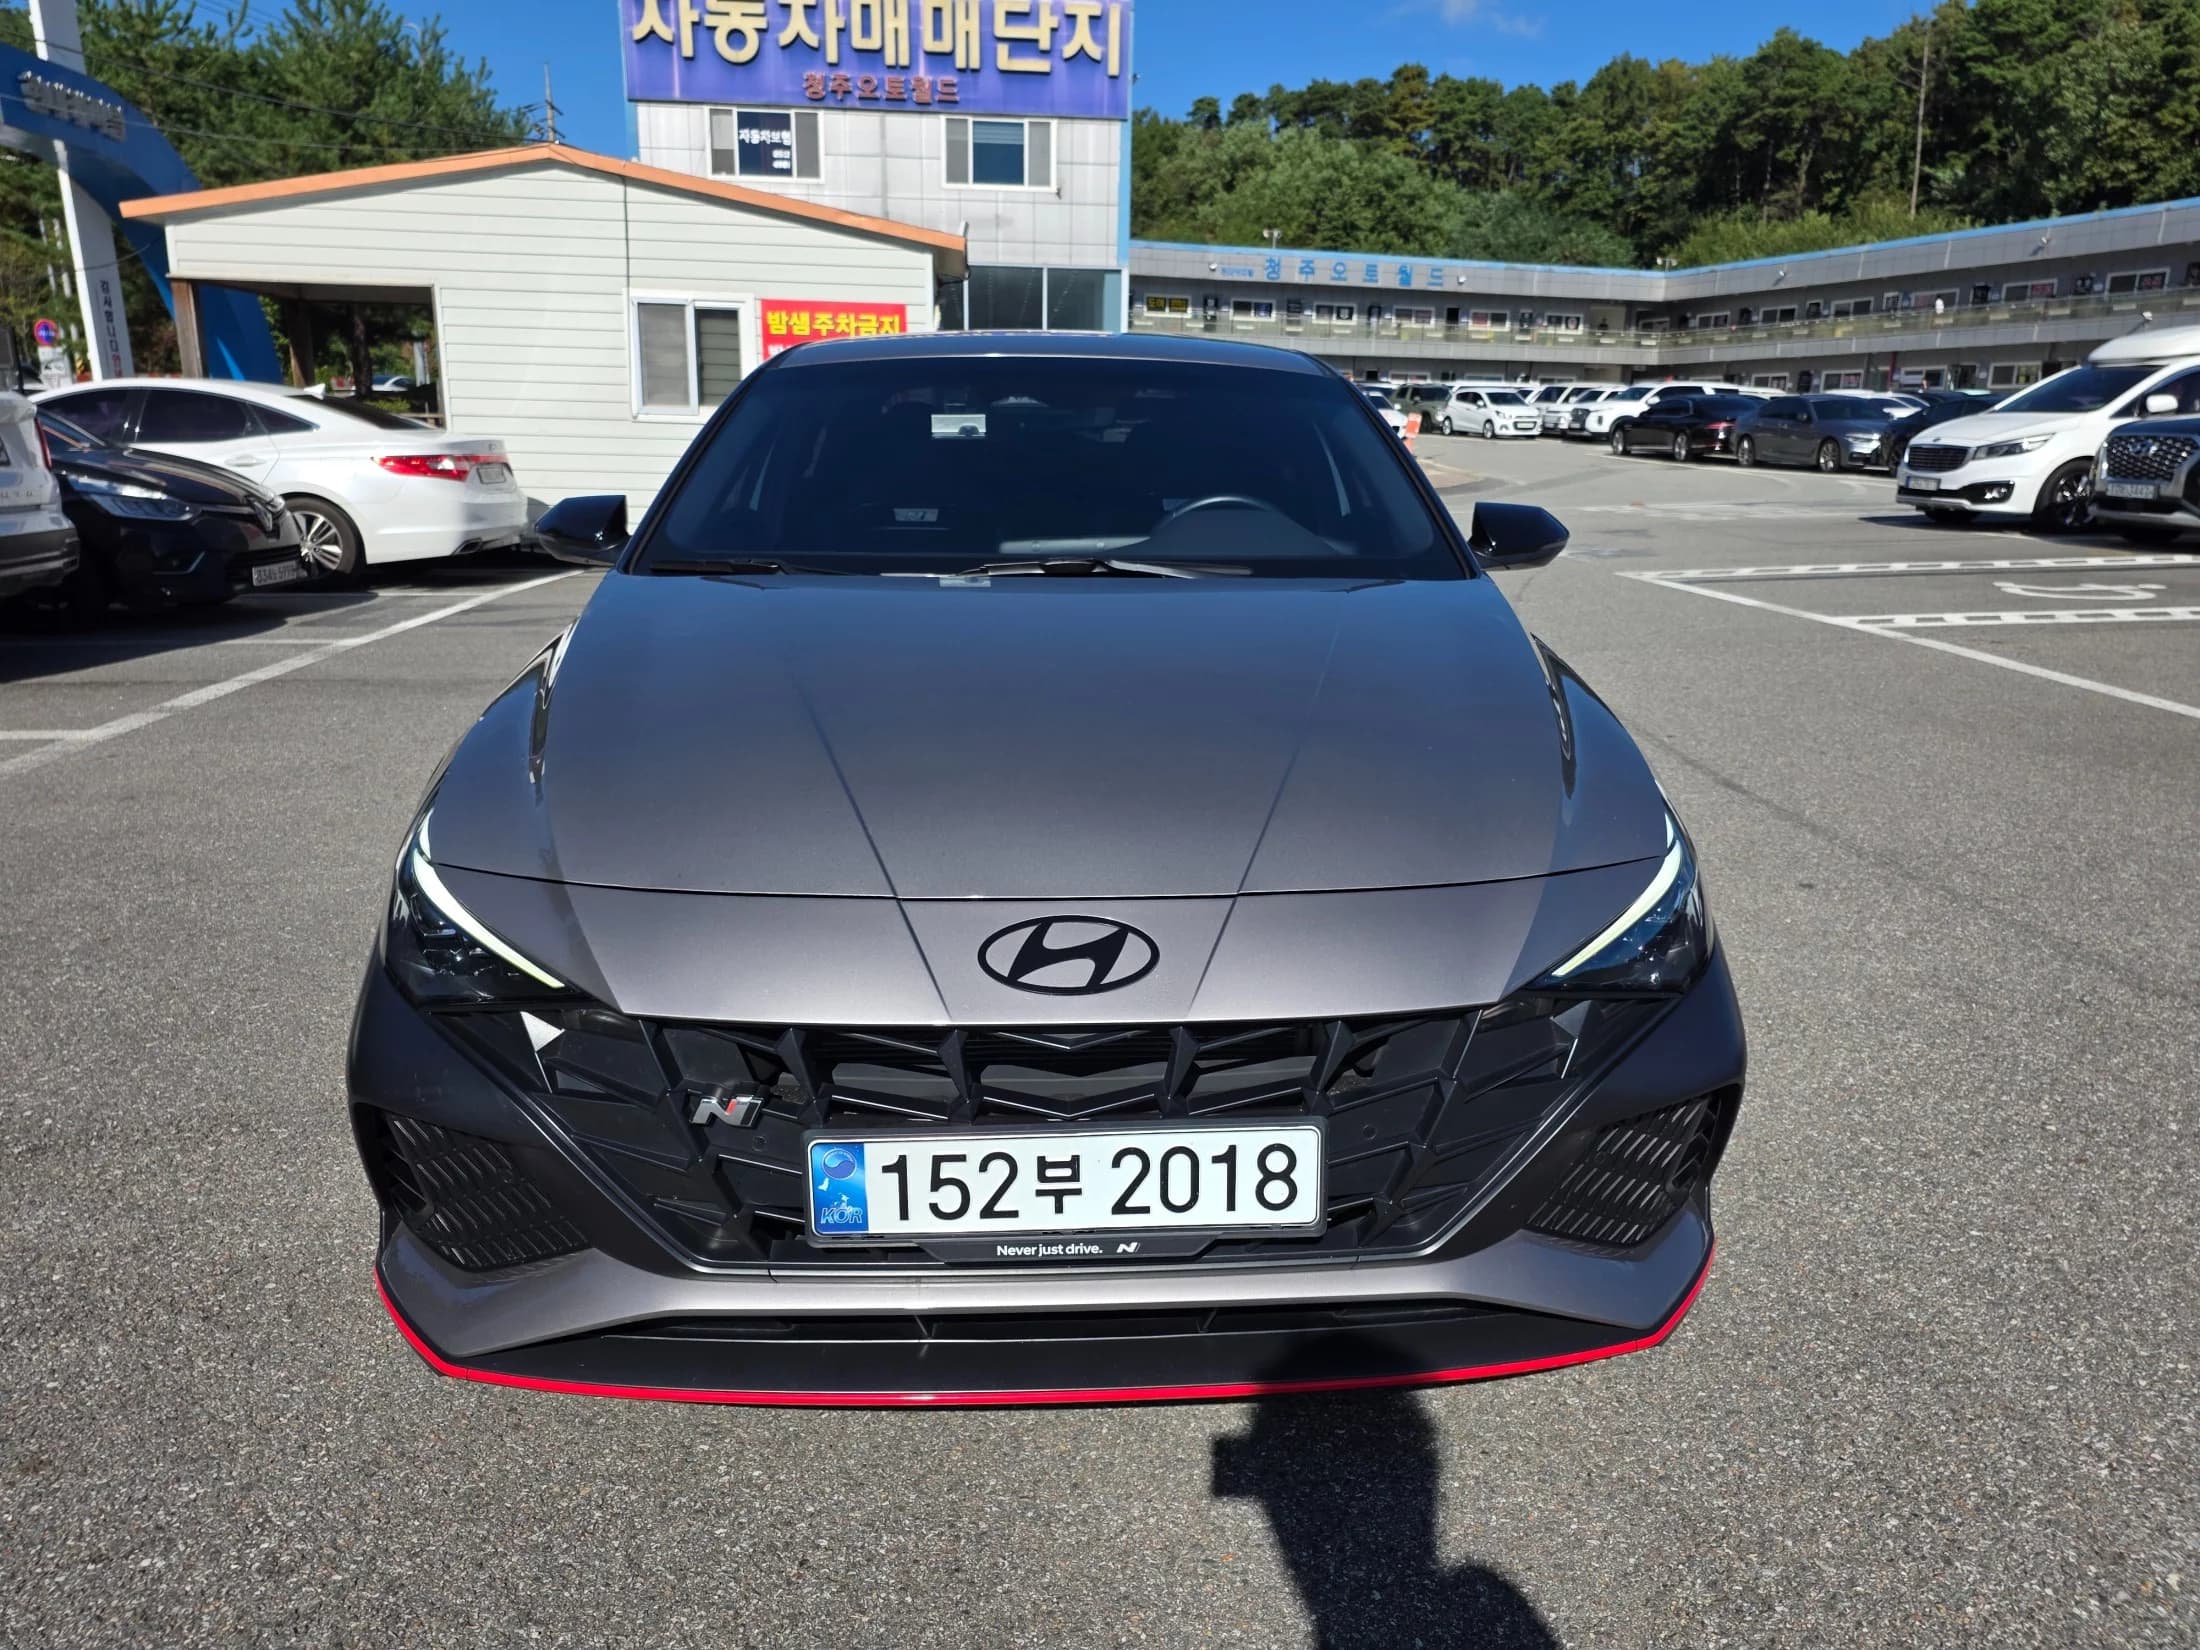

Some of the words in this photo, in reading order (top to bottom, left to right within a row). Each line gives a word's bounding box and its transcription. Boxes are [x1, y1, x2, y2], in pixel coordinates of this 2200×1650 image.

[803, 71, 960, 104] 청주오토월드
[1265, 257, 1444, 287] 청주오토월드
[881, 1151, 1083, 1221] 152부
[1111, 1142, 1298, 1215] 2018
[820, 1207, 863, 1224] KOR
[996, 1245, 1037, 1256] Never
[1038, 1243, 1063, 1257] just
[1065, 1242, 1103, 1255] drive.
